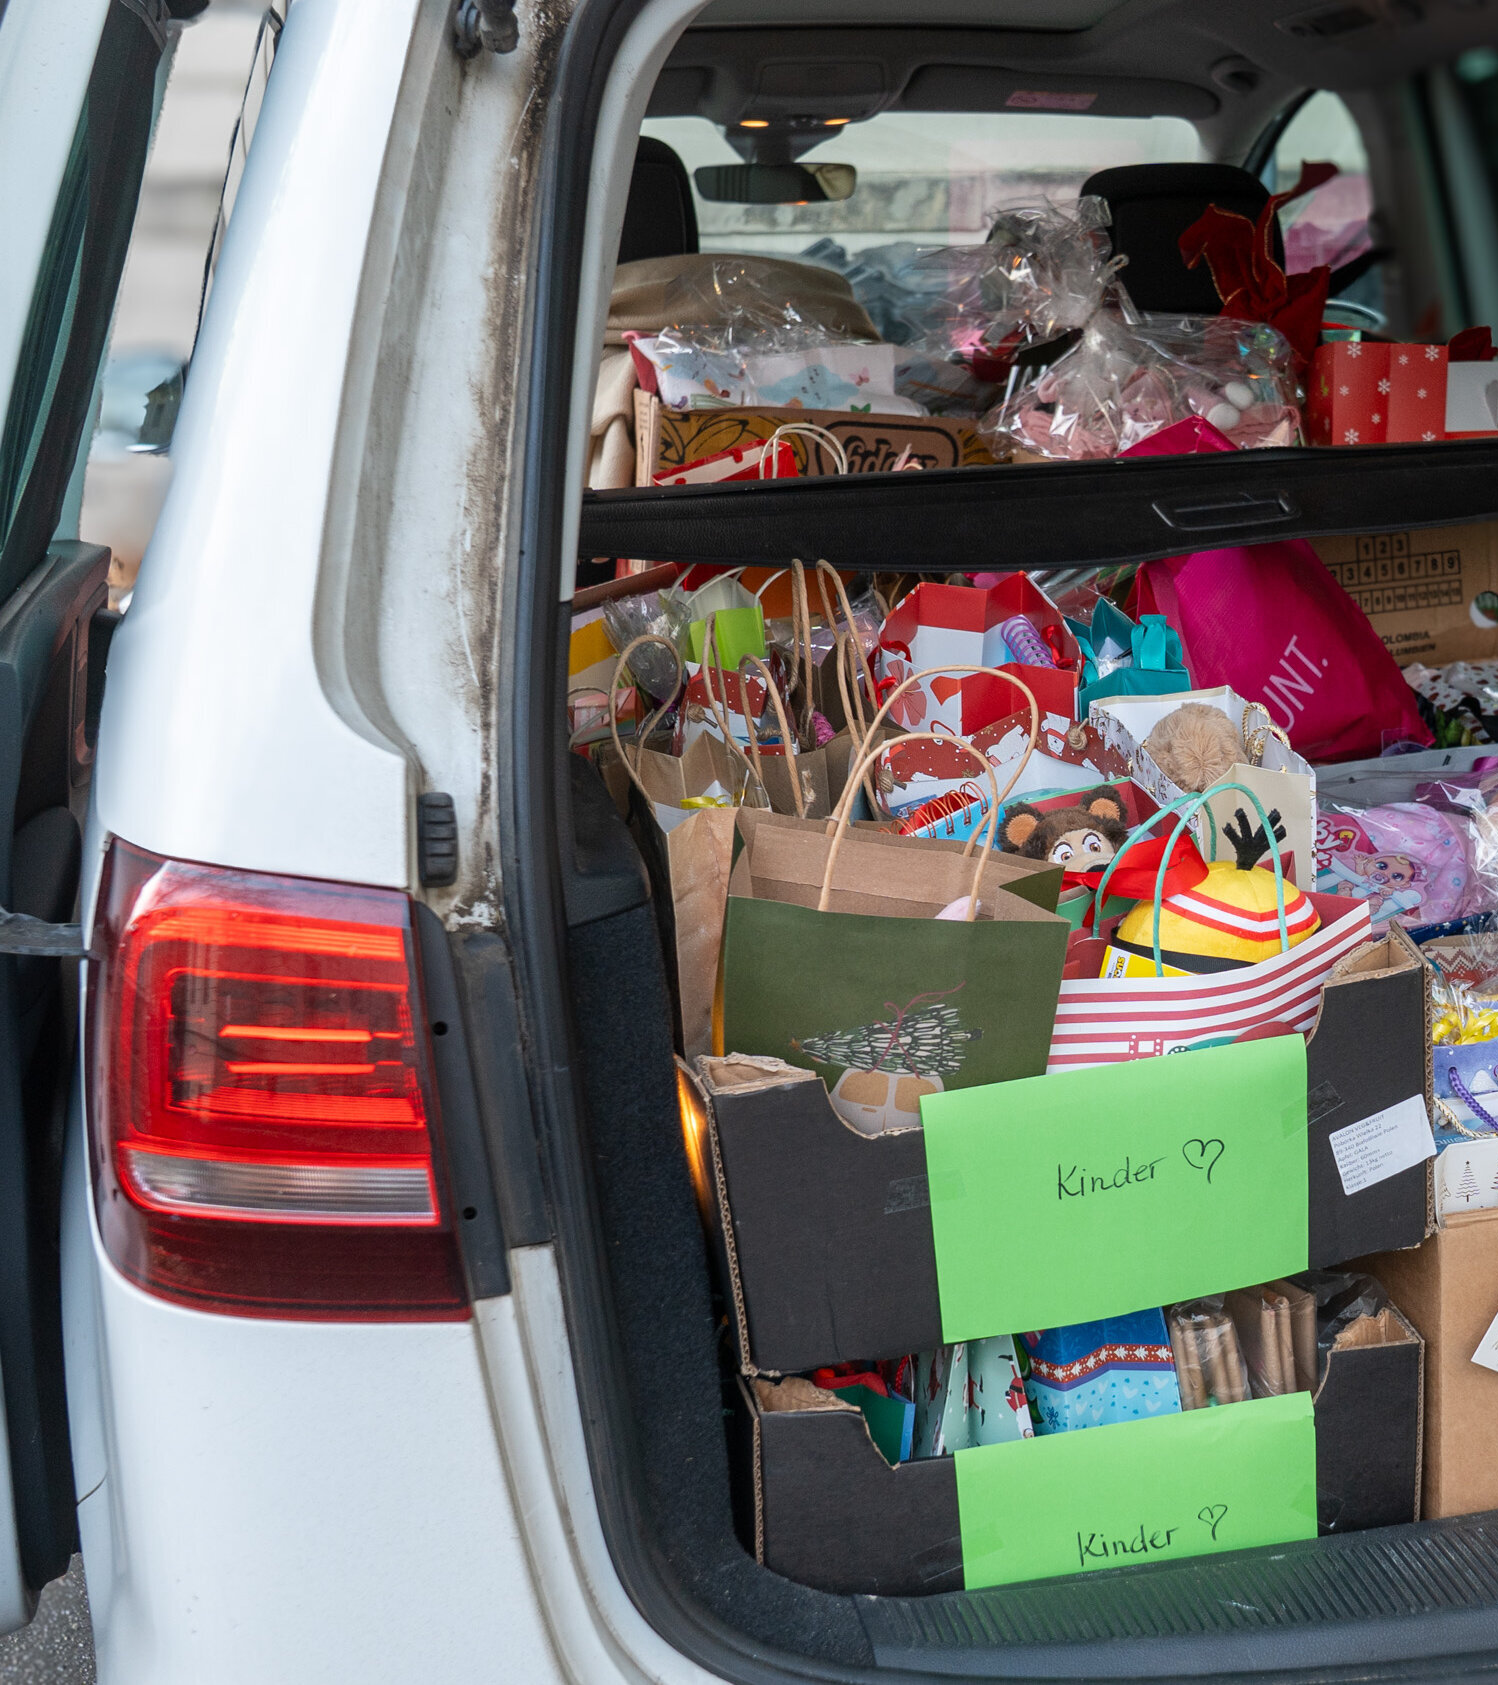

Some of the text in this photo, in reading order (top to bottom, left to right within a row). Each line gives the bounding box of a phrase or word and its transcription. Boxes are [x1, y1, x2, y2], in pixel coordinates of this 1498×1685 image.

[1364, 539, 1403, 555] 1 2 3
[1347, 567, 1354, 580] 3
[1363, 565, 1371, 578] 4
[1381, 564, 1388, 576] 5
[1397, 562, 1405, 574] 6
[1414, 560, 1421, 572] 7
[1431, 558, 1438, 571] 8
[1447, 556, 1455, 569] 9
[1381, 629, 1430, 645] OLOMBIA
[1389, 642, 1436, 656] LUMBIEN
[1262, 634, 1328, 733] UNT.
[1057, 1156, 1168, 1200] Kinder
[1077, 1524, 1180, 1567] Kinder
